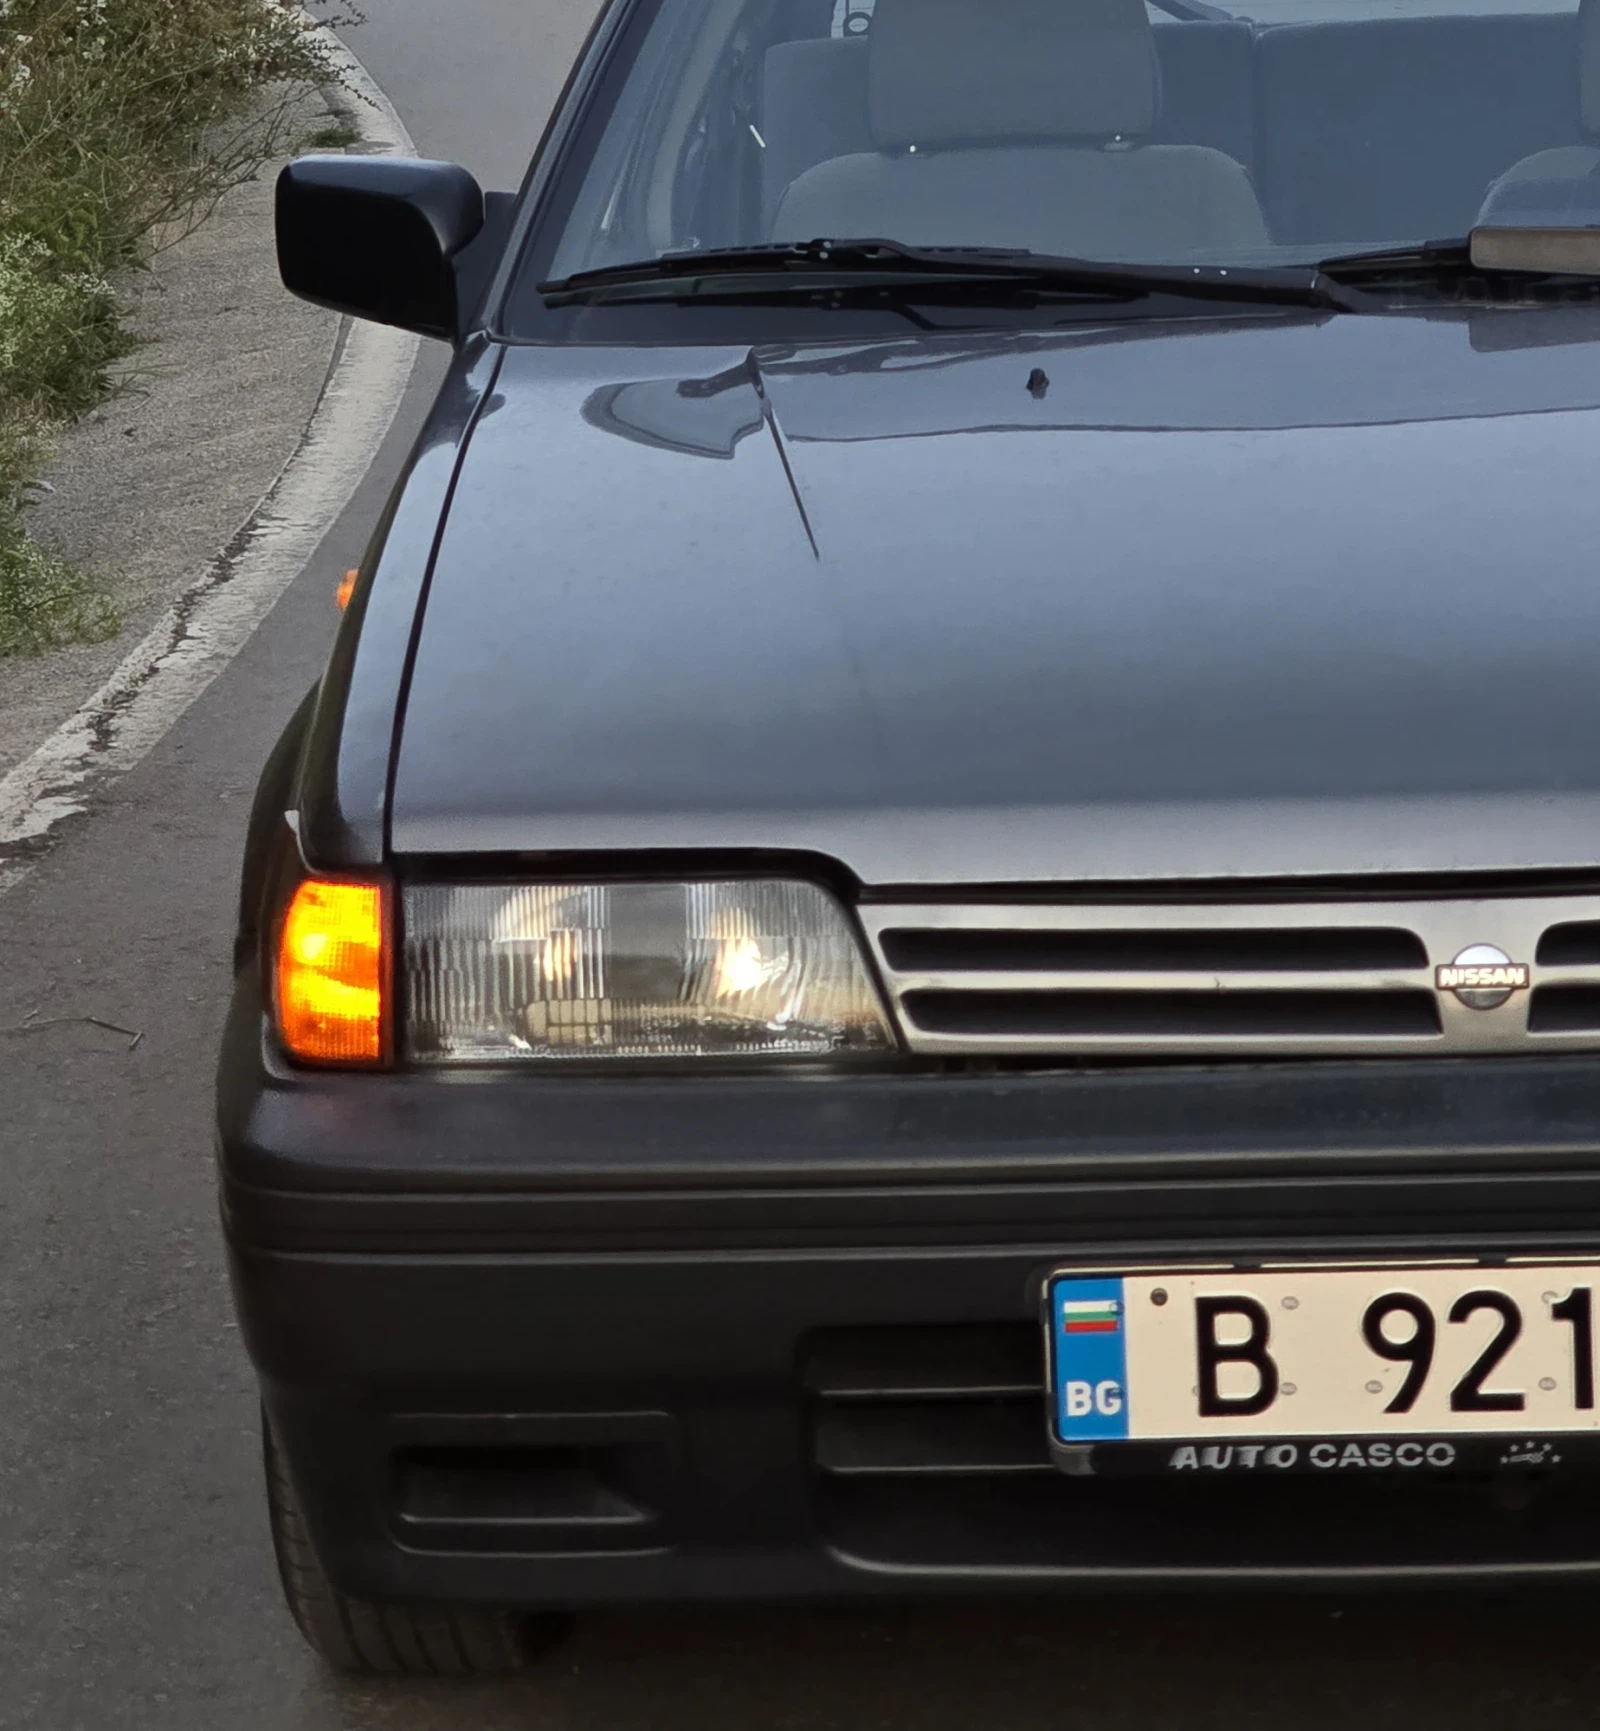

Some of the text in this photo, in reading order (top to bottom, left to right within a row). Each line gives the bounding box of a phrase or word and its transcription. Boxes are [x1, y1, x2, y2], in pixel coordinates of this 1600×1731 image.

[1440, 967, 1525, 986] NISSAN
[1195, 1286, 1595, 1417] B 921
[1066, 1380, 1122, 1416] BG
[1169, 1442, 1456, 1470] AUTO CASCO
